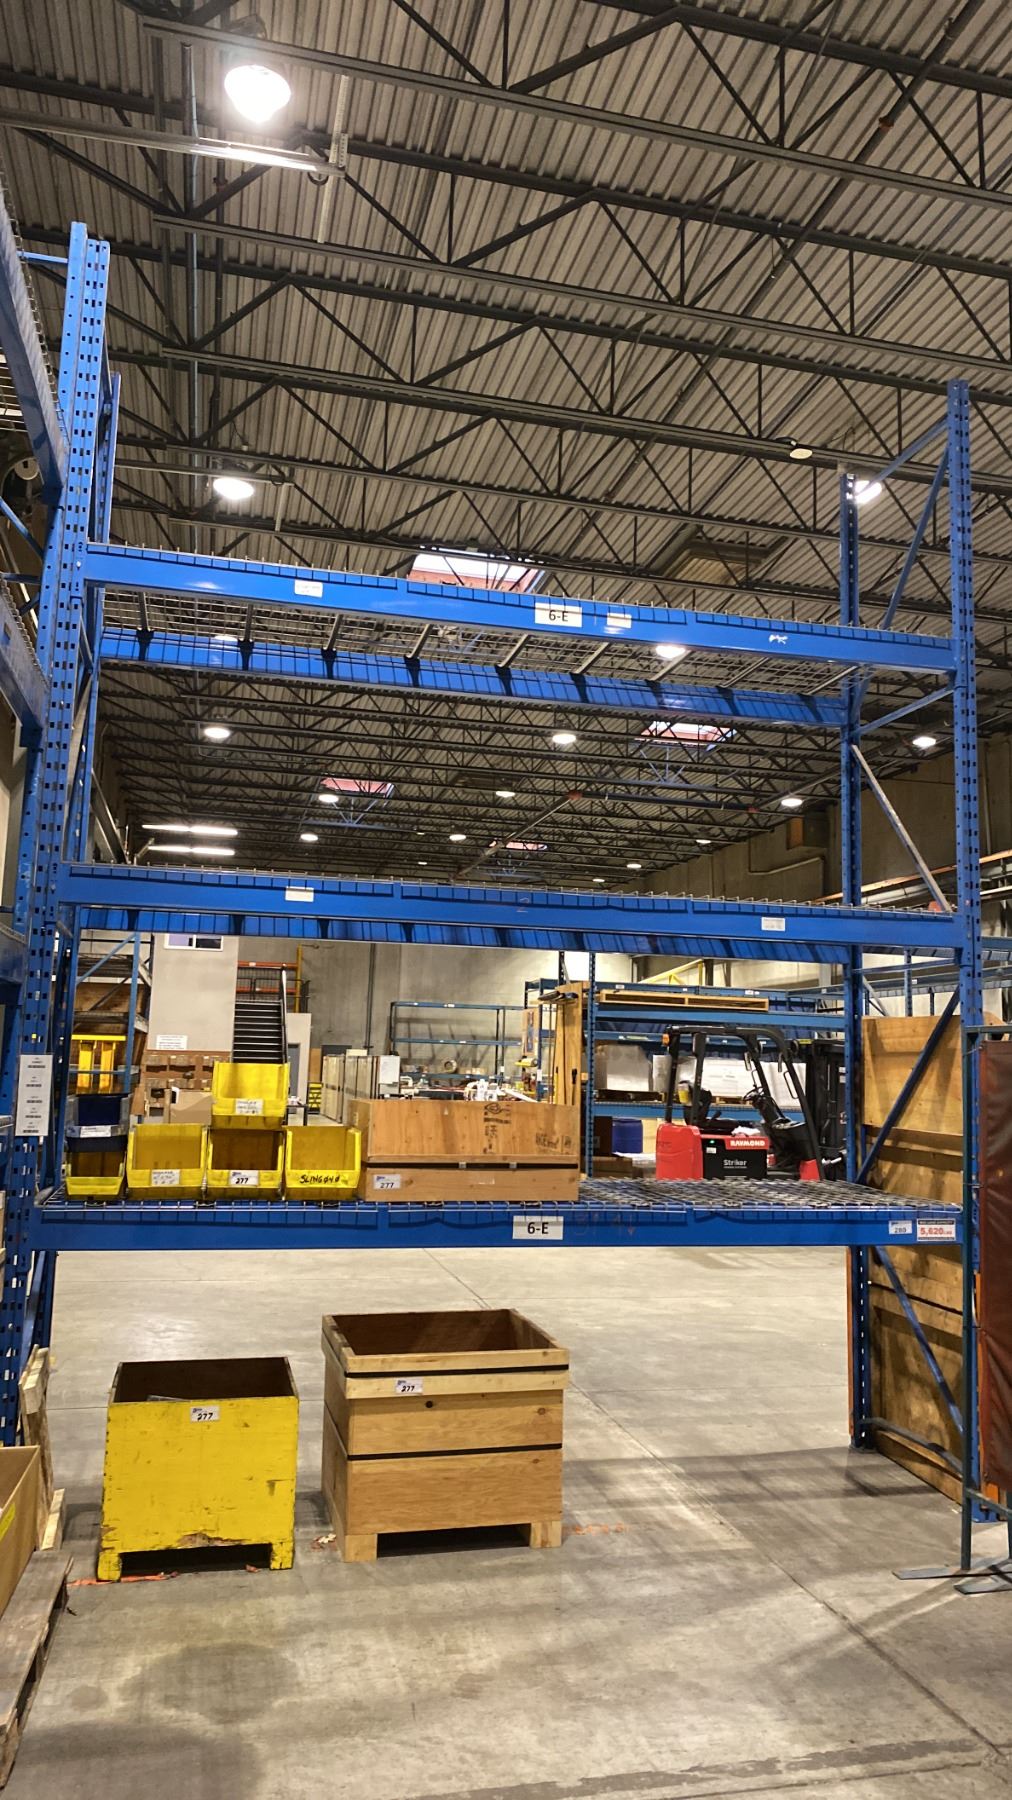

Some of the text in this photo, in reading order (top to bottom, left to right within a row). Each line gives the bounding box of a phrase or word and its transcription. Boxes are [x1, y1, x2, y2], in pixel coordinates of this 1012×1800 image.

[548, 610, 569, 622] 6-E
[235, 1177, 249, 1185] 277
[527, 1221, 549, 1235] 6-E
[920, 1227, 944, 1237] 5,620
[197, 1412, 214, 1421] 277
